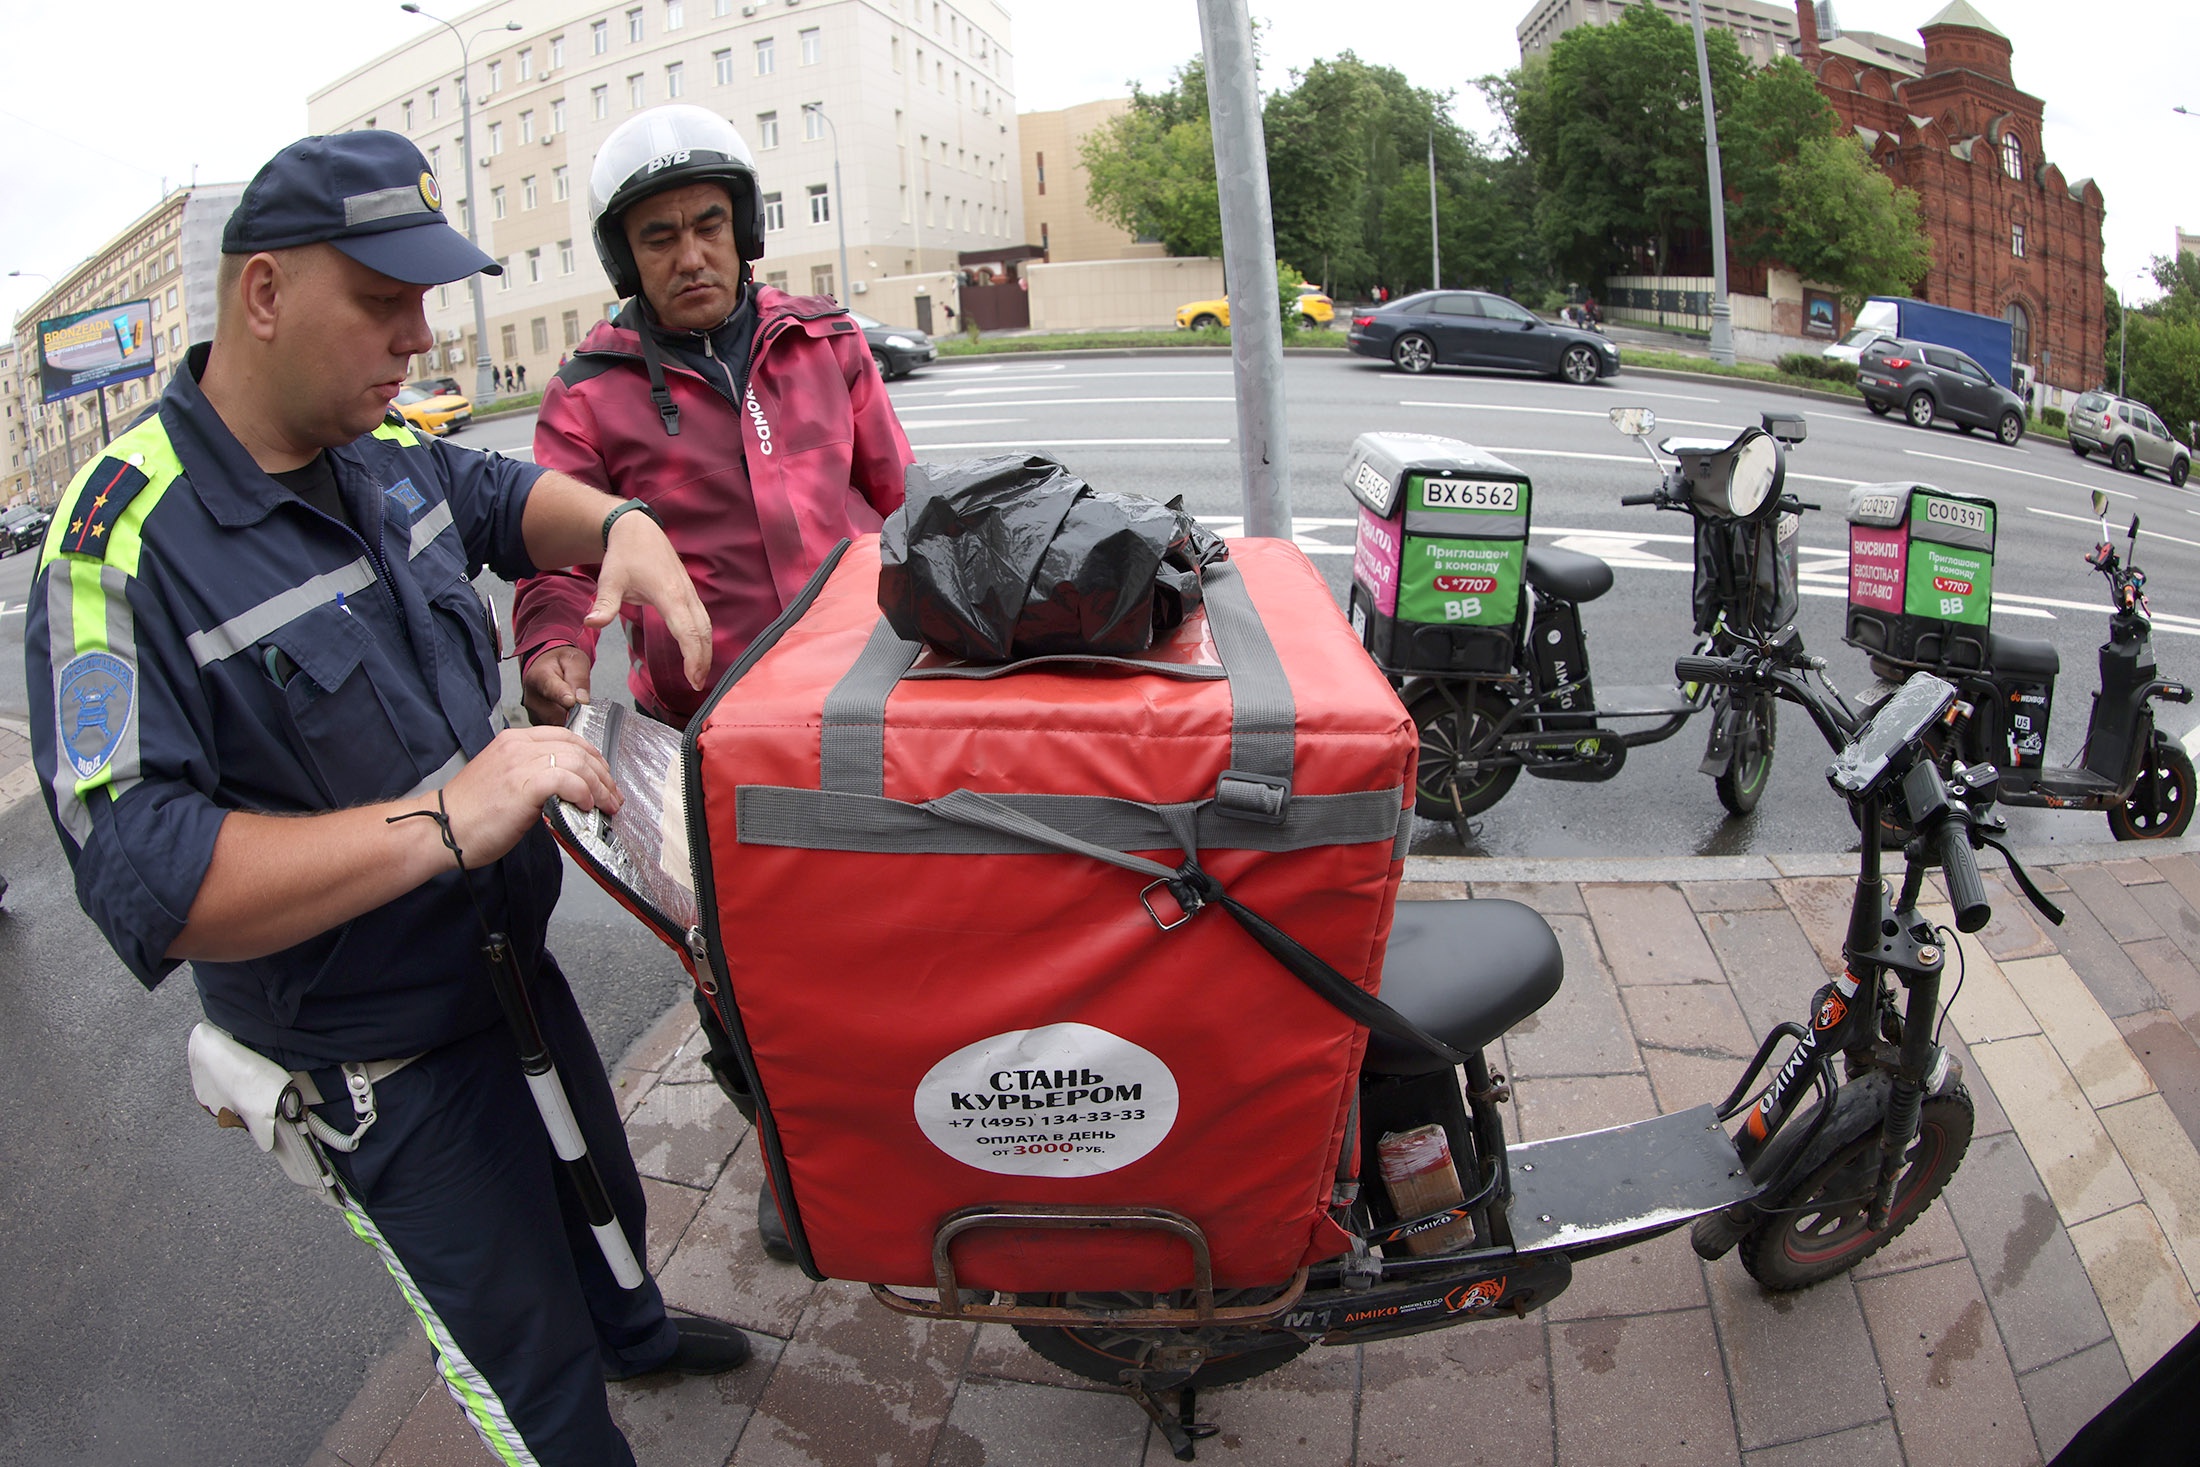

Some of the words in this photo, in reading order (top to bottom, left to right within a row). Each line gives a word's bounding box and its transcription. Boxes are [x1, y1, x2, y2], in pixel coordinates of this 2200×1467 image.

[646, 150, 691, 174] BYB
[44, 320, 111, 344] BRONZEADA
[746, 381, 773, 455] самок
[1428, 483, 1514, 506] ВХ6562
[1929, 502, 1983, 528] СО0397
[1426, 544, 1509, 562] Приглашаем
[1854, 541, 1899, 558] ВКУСВИЛЛ
[1434, 561, 1442, 569] в
[1445, 561, 1500, 574] команду
[1928, 552, 1980, 569] Приглашаем
[1933, 564, 1939, 572] в
[1940, 565, 1975, 580] команду
[1445, 597, 1482, 620] ВВ
[1940, 597, 1964, 615] ВВ
[64, 659, 130, 683] ПОЛИЦИЯ
[1554, 660, 1574, 710] AIMKO
[78, 755, 101, 776] МВД
[989, 1069, 1104, 1091] СТАНЬ
[1760, 1028, 1817, 1114] AIMIKO
[951, 1083, 1142, 1111] КУРЬЕРОМ
[949, 1118, 975, 1128] +7
[981, 1116, 1034, 1129] (495)
[1042, 1110, 1146, 1126] 134-33-33
[976, 1134, 1050, 1144] ОПЛАТА
[1053, 1133, 1063, 1141] В
[1068, 1131, 1116, 1142] ДЕНЬ
[1013, 1142, 1074, 1155] 3000
[1076, 1146, 1105, 1154] РУБ.
[1406, 1216, 1451, 1236] AIMIKO
[1284, 1310, 1332, 1327] M1
[1345, 1306, 1398, 1323] AIMIKO
